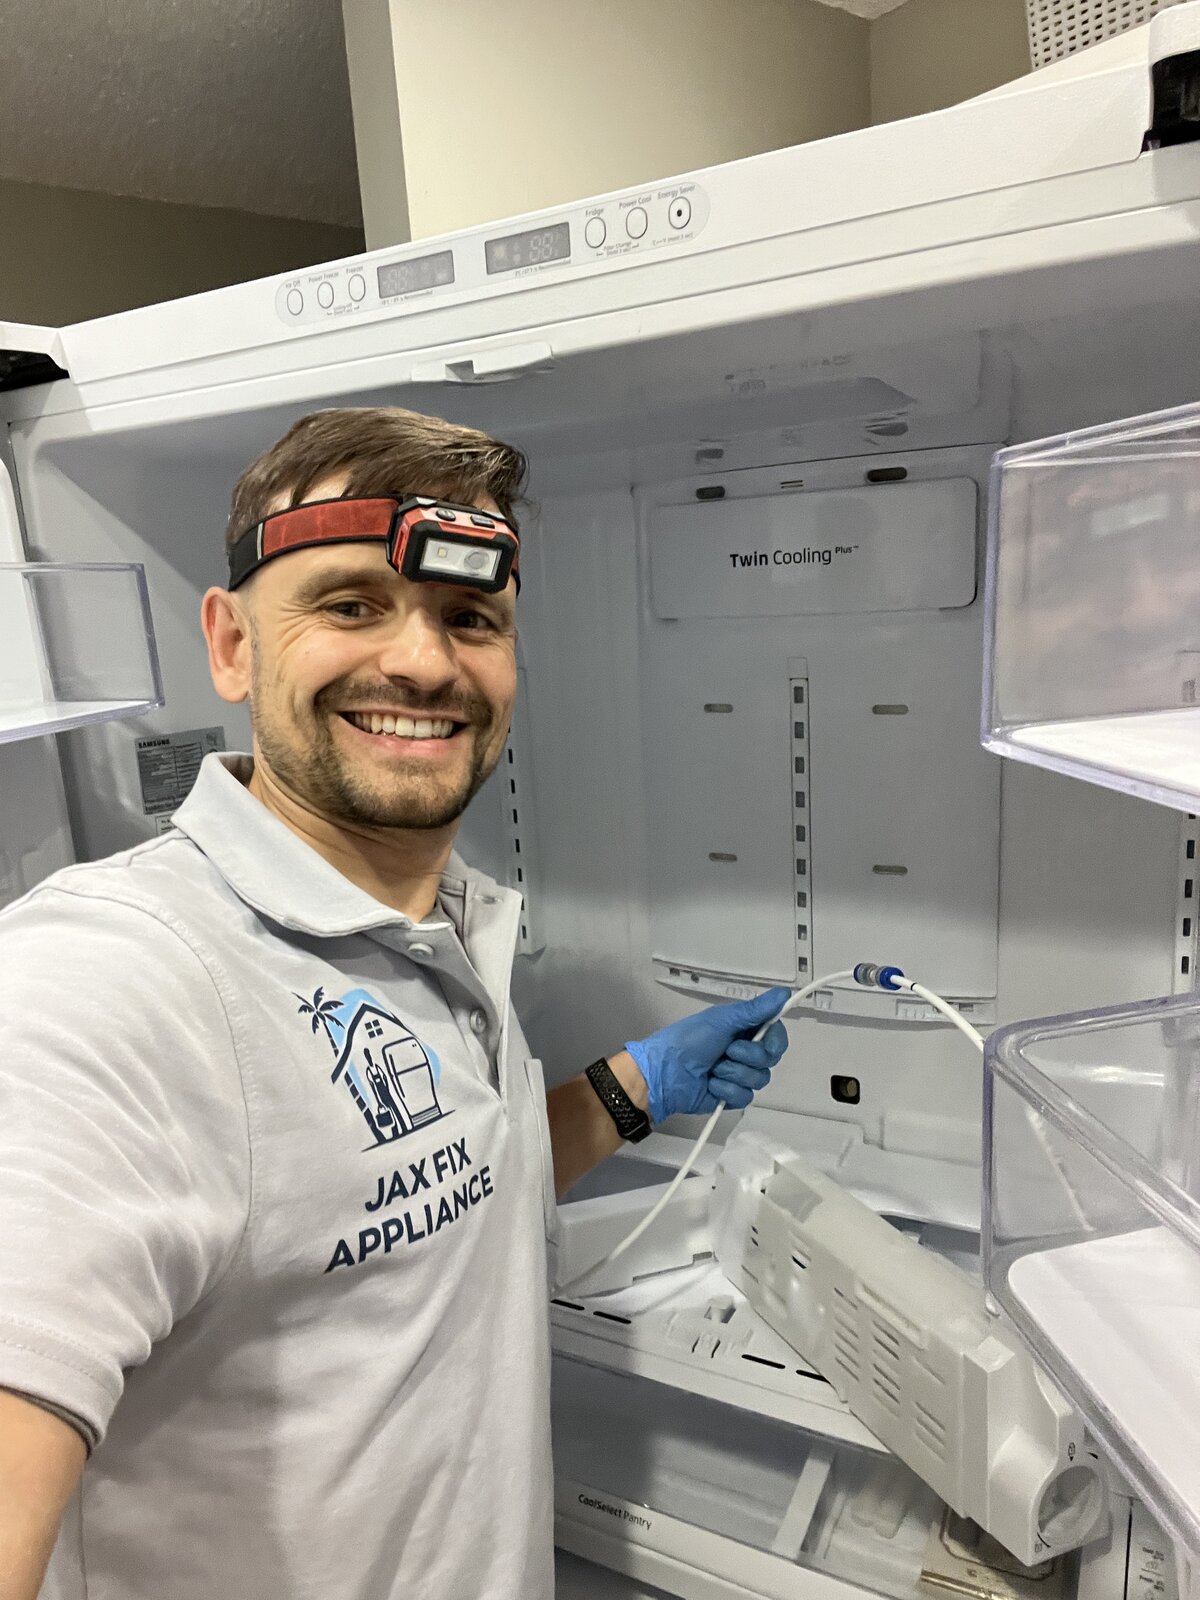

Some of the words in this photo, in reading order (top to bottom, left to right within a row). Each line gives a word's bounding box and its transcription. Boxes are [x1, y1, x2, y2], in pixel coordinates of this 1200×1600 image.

[585, 207, 604, 217] Fridge
[619, 199, 637, 209] Power
[729, 551, 768, 568] Twin
[773, 547, 832, 565] Cooling
[138, 739, 170, 749] SAMSUNG
[364, 1157, 431, 1212] JAX
[432, 1137, 472, 1184] FIX
[323, 1165, 494, 1274] APPLIANCE
[578, 1494, 622, 1518] CoolSelect
[623, 1510, 652, 1530] Pantry
